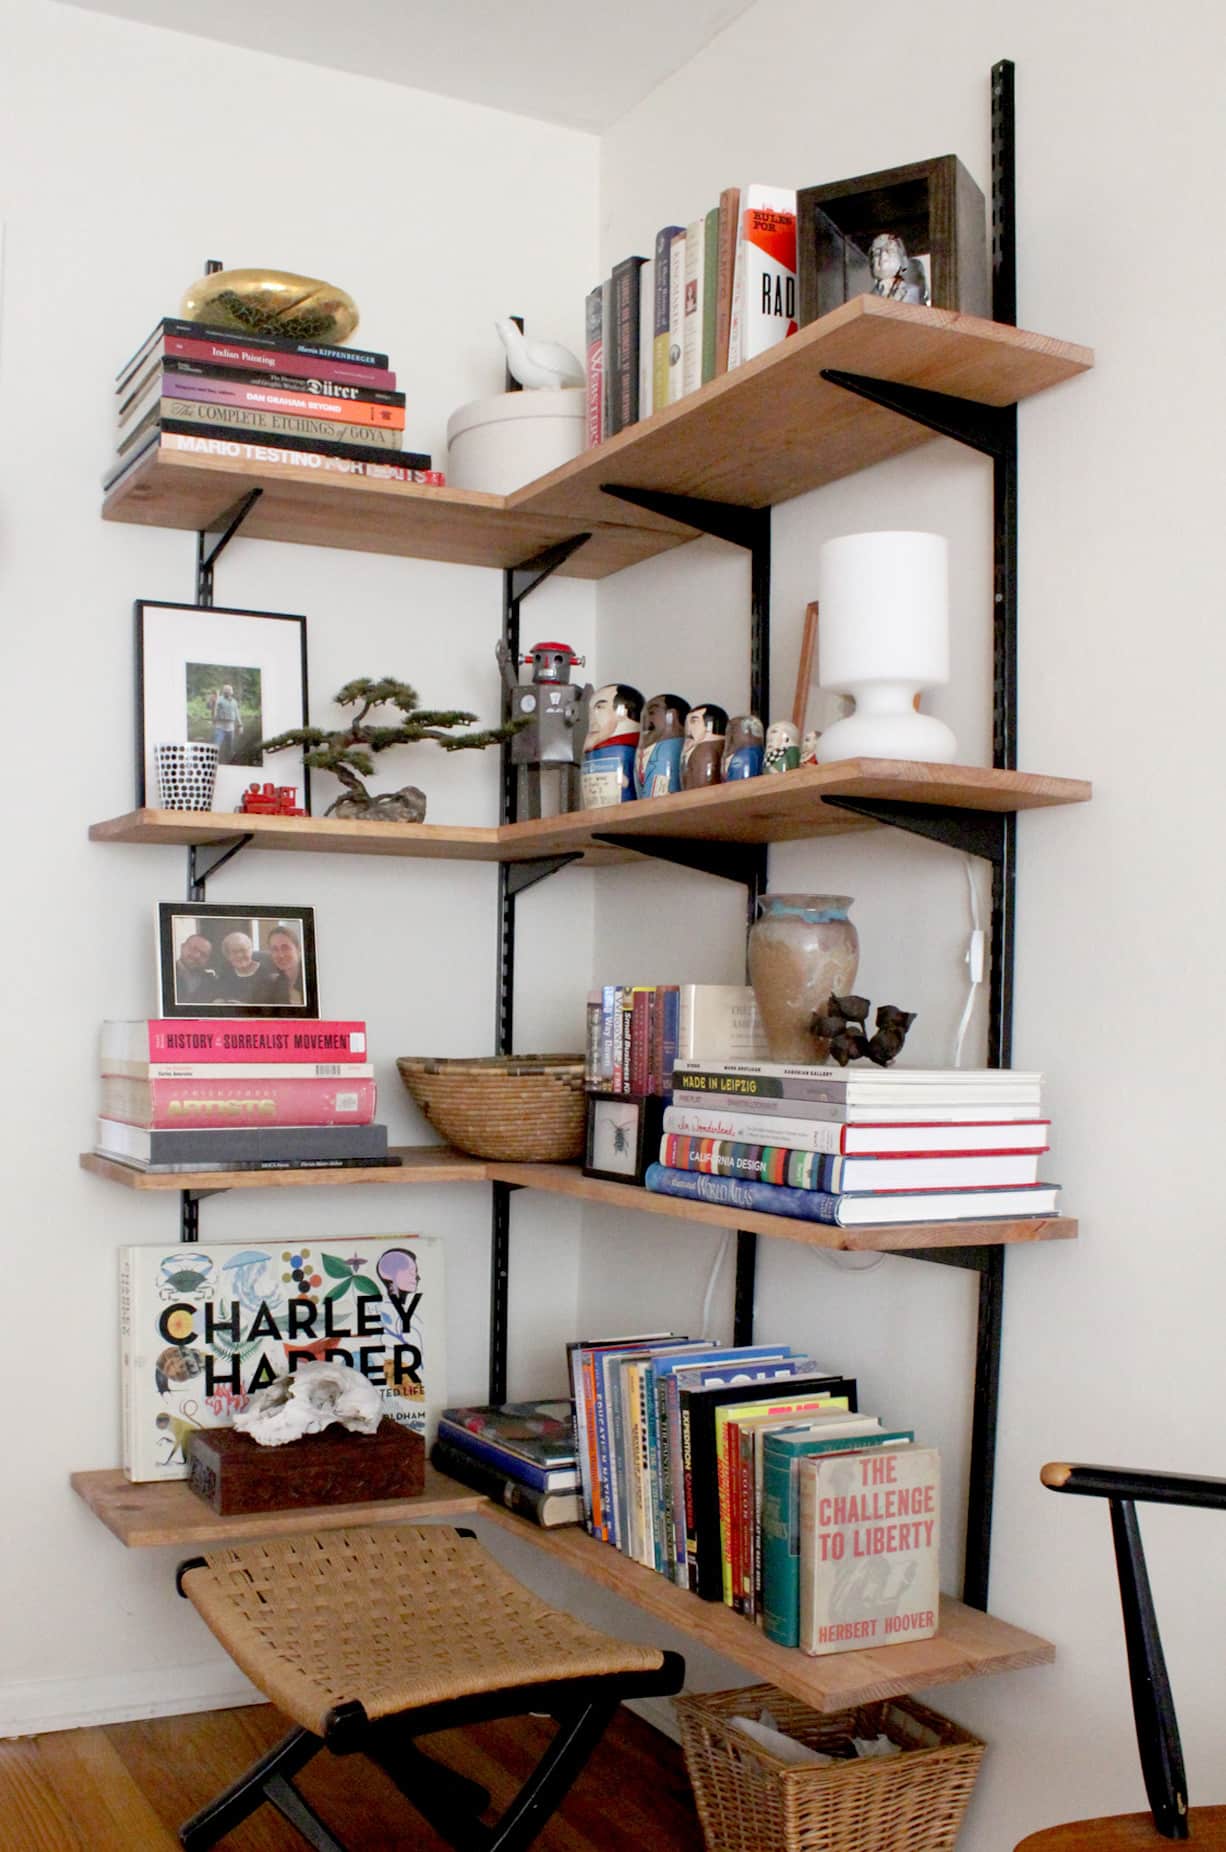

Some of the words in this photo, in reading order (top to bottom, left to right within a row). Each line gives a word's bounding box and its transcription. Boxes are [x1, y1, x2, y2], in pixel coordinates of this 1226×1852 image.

[753, 220, 776, 232] FOR
[212, 346, 240, 361] Indian
[241, 350, 276, 367] Painting
[246, 391, 265, 402] DAN
[308, 400, 342, 413] BEYOND
[306, 378, 360, 401] Dürer
[171, 402, 194, 418] The
[197, 405, 266, 428] COMPLETE
[272, 413, 336, 436] ETCHINGS
[336, 425, 348, 443] of
[350, 427, 386, 444] GOYA
[177, 436, 238, 457] MARIO
[245, 441, 321, 469] TESTINO
[167, 1033, 213, 1049] HISTORY
[223, 1034, 289, 1049] SURREALIST
[623, 1040, 631, 1081] Business
[682, 1075, 706, 1089] MADE
[708, 1077, 718, 1090] IN
[720, 1078, 758, 1093] LEIPZIG
[736, 1158, 767, 1172] DESIGN
[158, 1292, 423, 1346] CHARLEY
[404, 1386, 425, 1397] LIFE
[681, 1409, 692, 1470] EXPEDITION
[859, 1455, 897, 1487] THE
[602, 1466, 611, 1513] NATION
[818, 1485, 936, 1526] CHALLENGE
[818, 1532, 846, 1561] TO
[853, 1519, 936, 1557] LIBERTY
[818, 1619, 878, 1643] HERBERT
[884, 1610, 936, 1634] HOOVER
